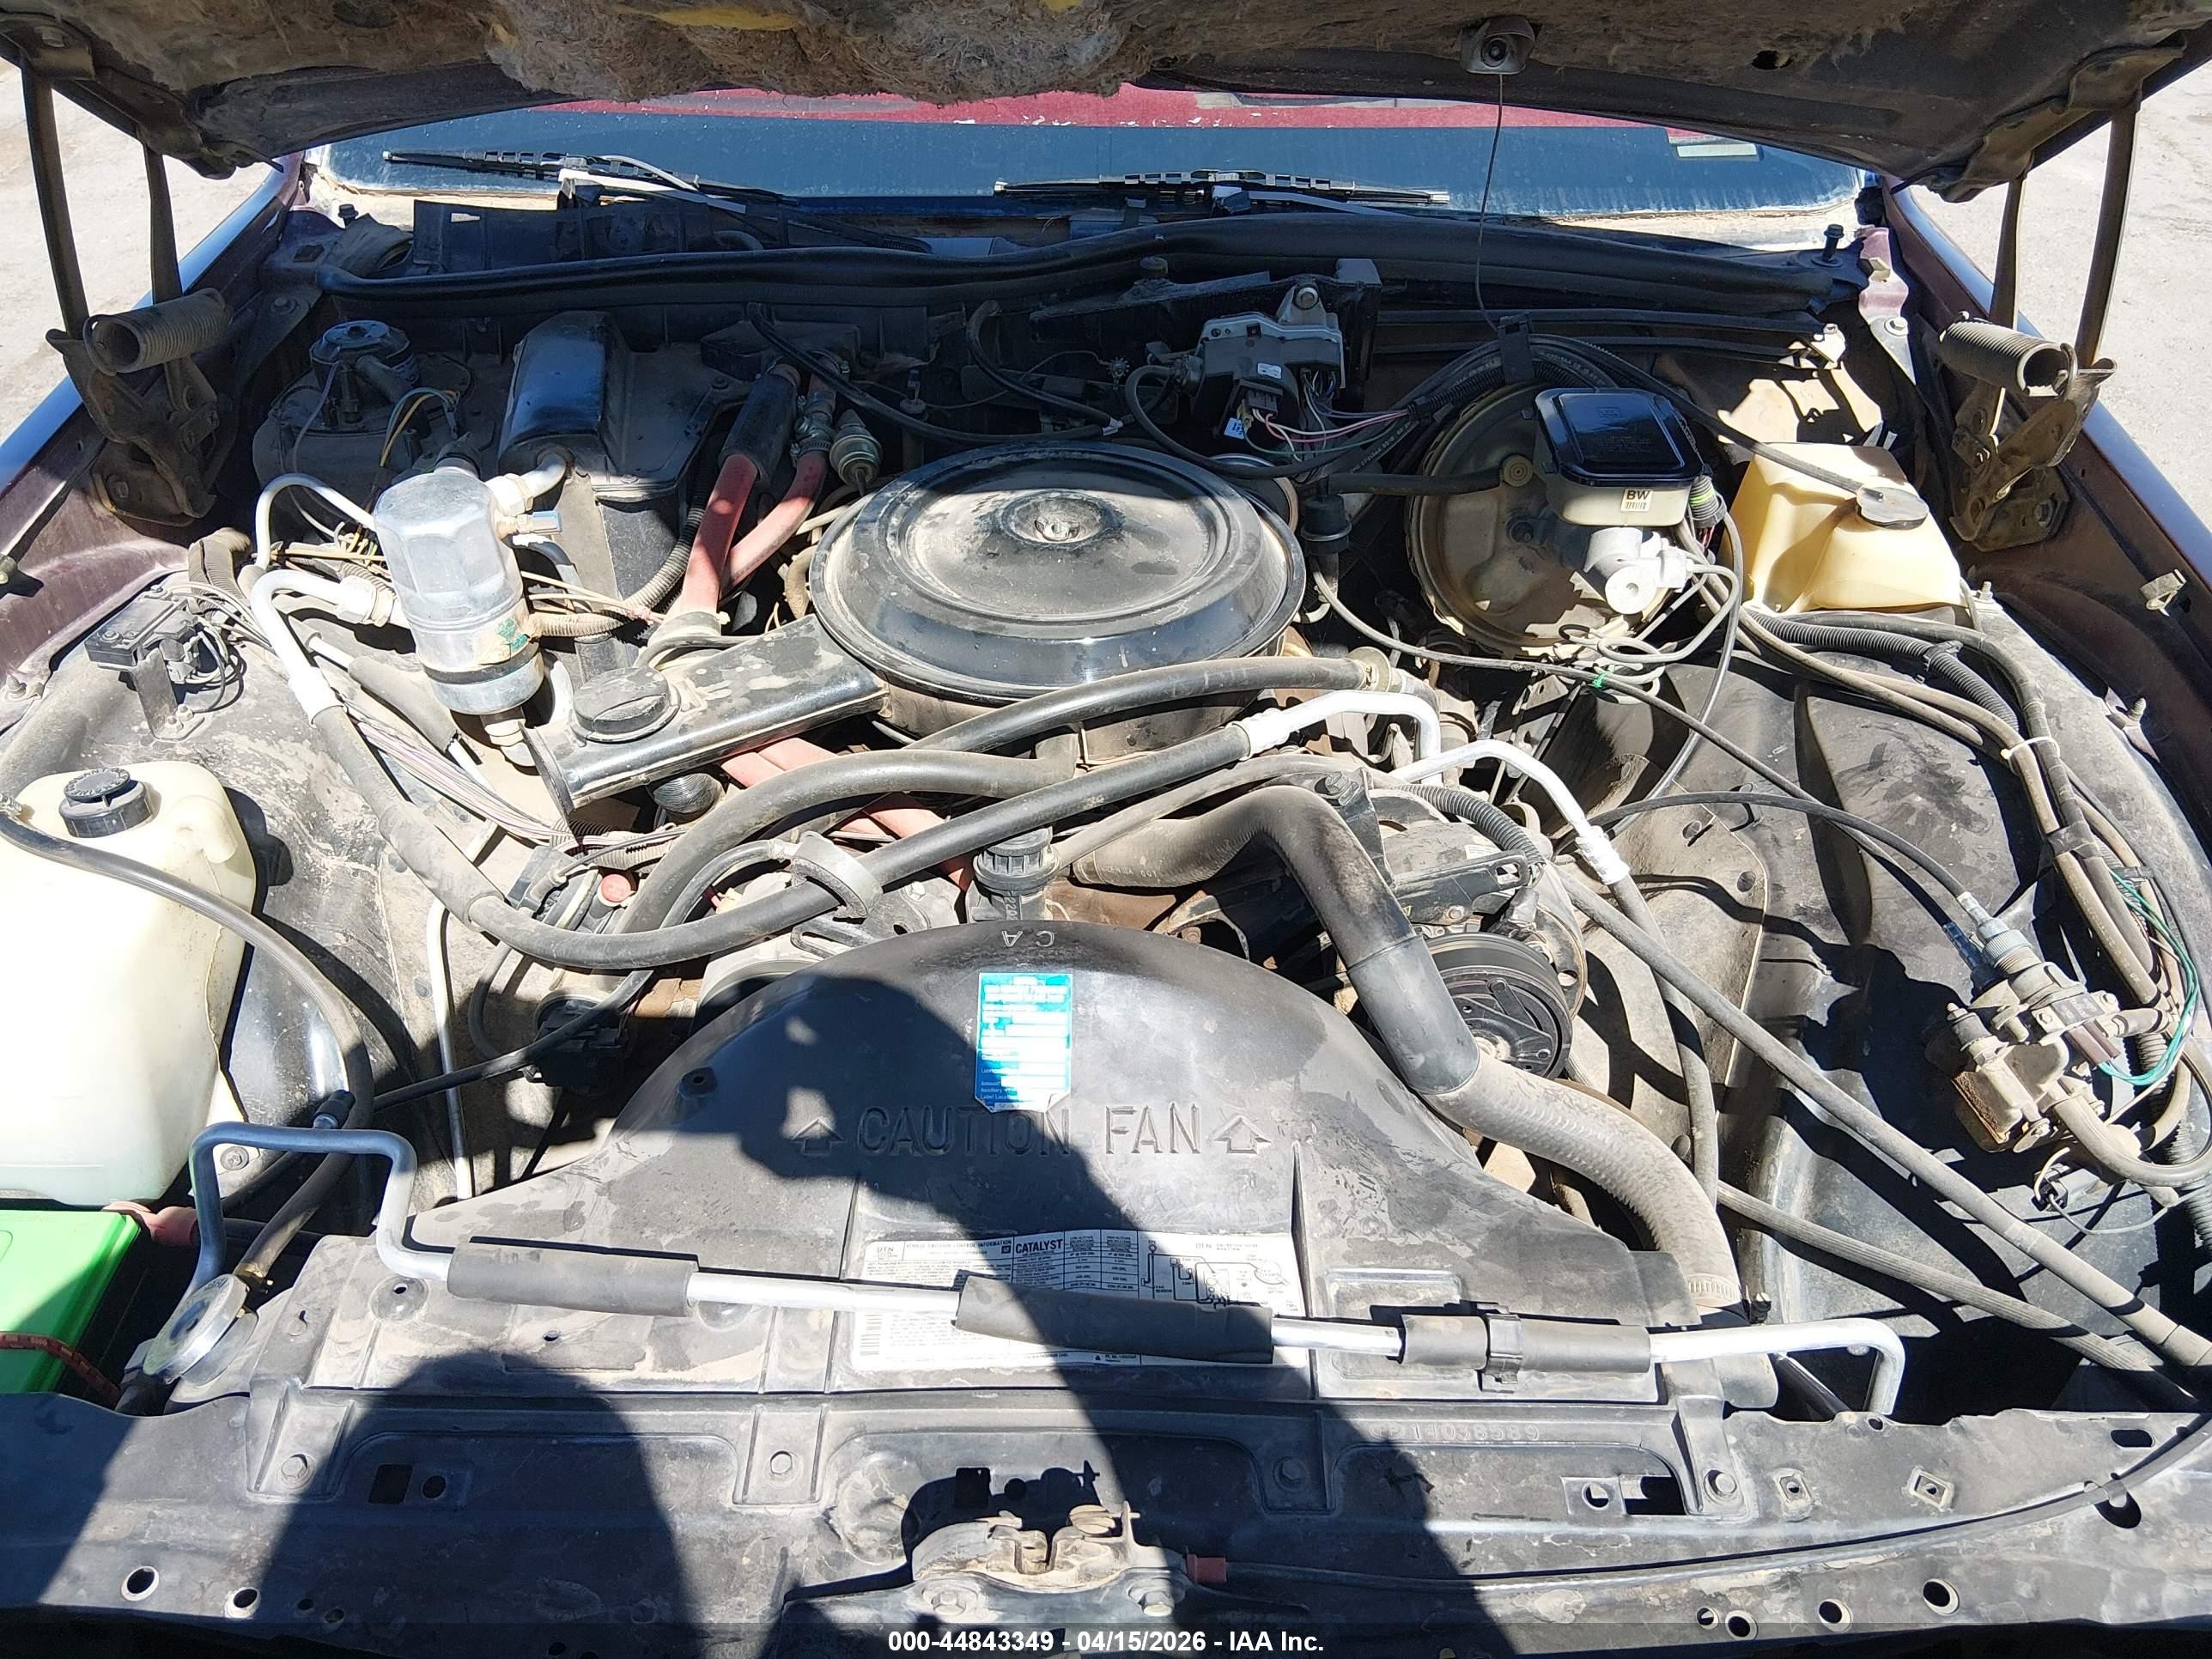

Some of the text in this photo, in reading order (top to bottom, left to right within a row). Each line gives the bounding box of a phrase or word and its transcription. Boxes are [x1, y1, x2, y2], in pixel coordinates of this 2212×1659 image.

[1626, 489, 1651, 501] BW
[860, 1102, 1201, 1156] CAUTION FAN
[1015, 1238, 1064, 1254] CATALYST
[1411, 1422, 1540, 1441] 14038589
